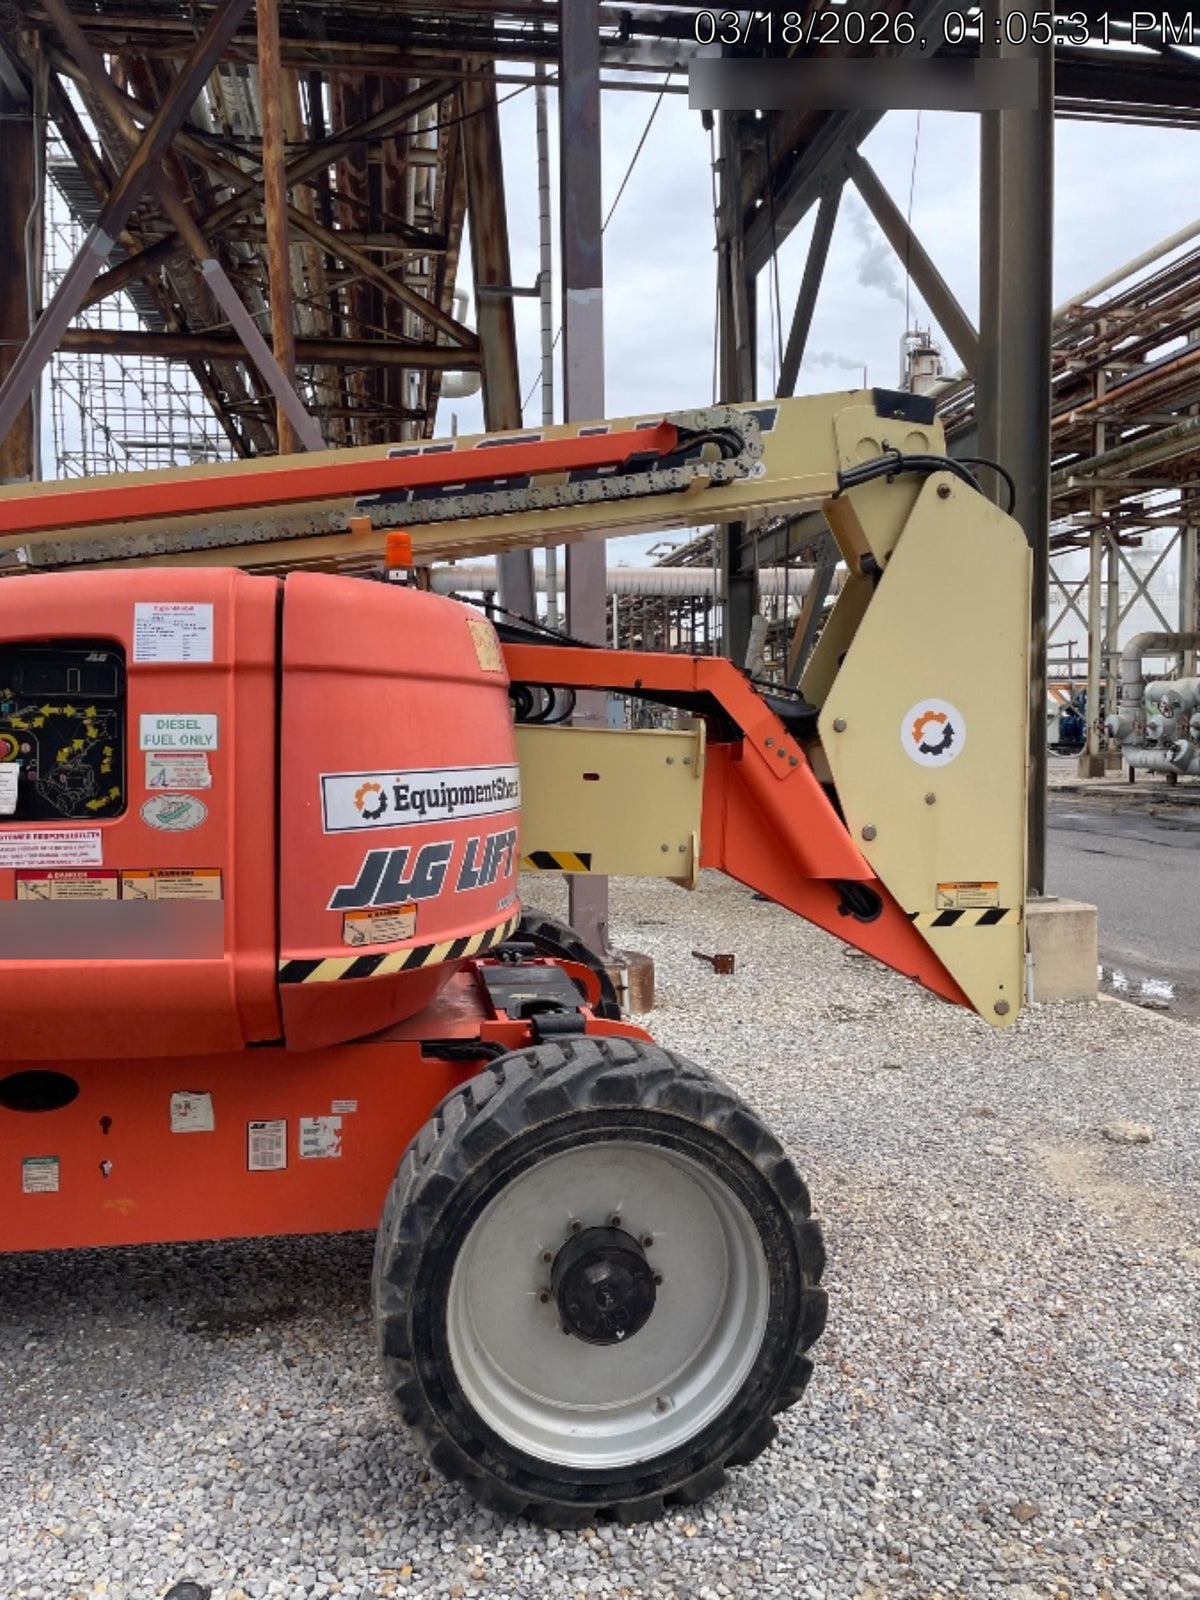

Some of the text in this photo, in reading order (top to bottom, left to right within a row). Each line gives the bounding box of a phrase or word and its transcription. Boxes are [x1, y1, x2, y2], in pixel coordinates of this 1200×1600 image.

[156, 719, 201, 730] DIESEL
[144, 734, 213, 746] FUEL ONLY
[392, 776, 519, 815] EquipmentShar
[326, 826, 518, 911] JLG LIFT
